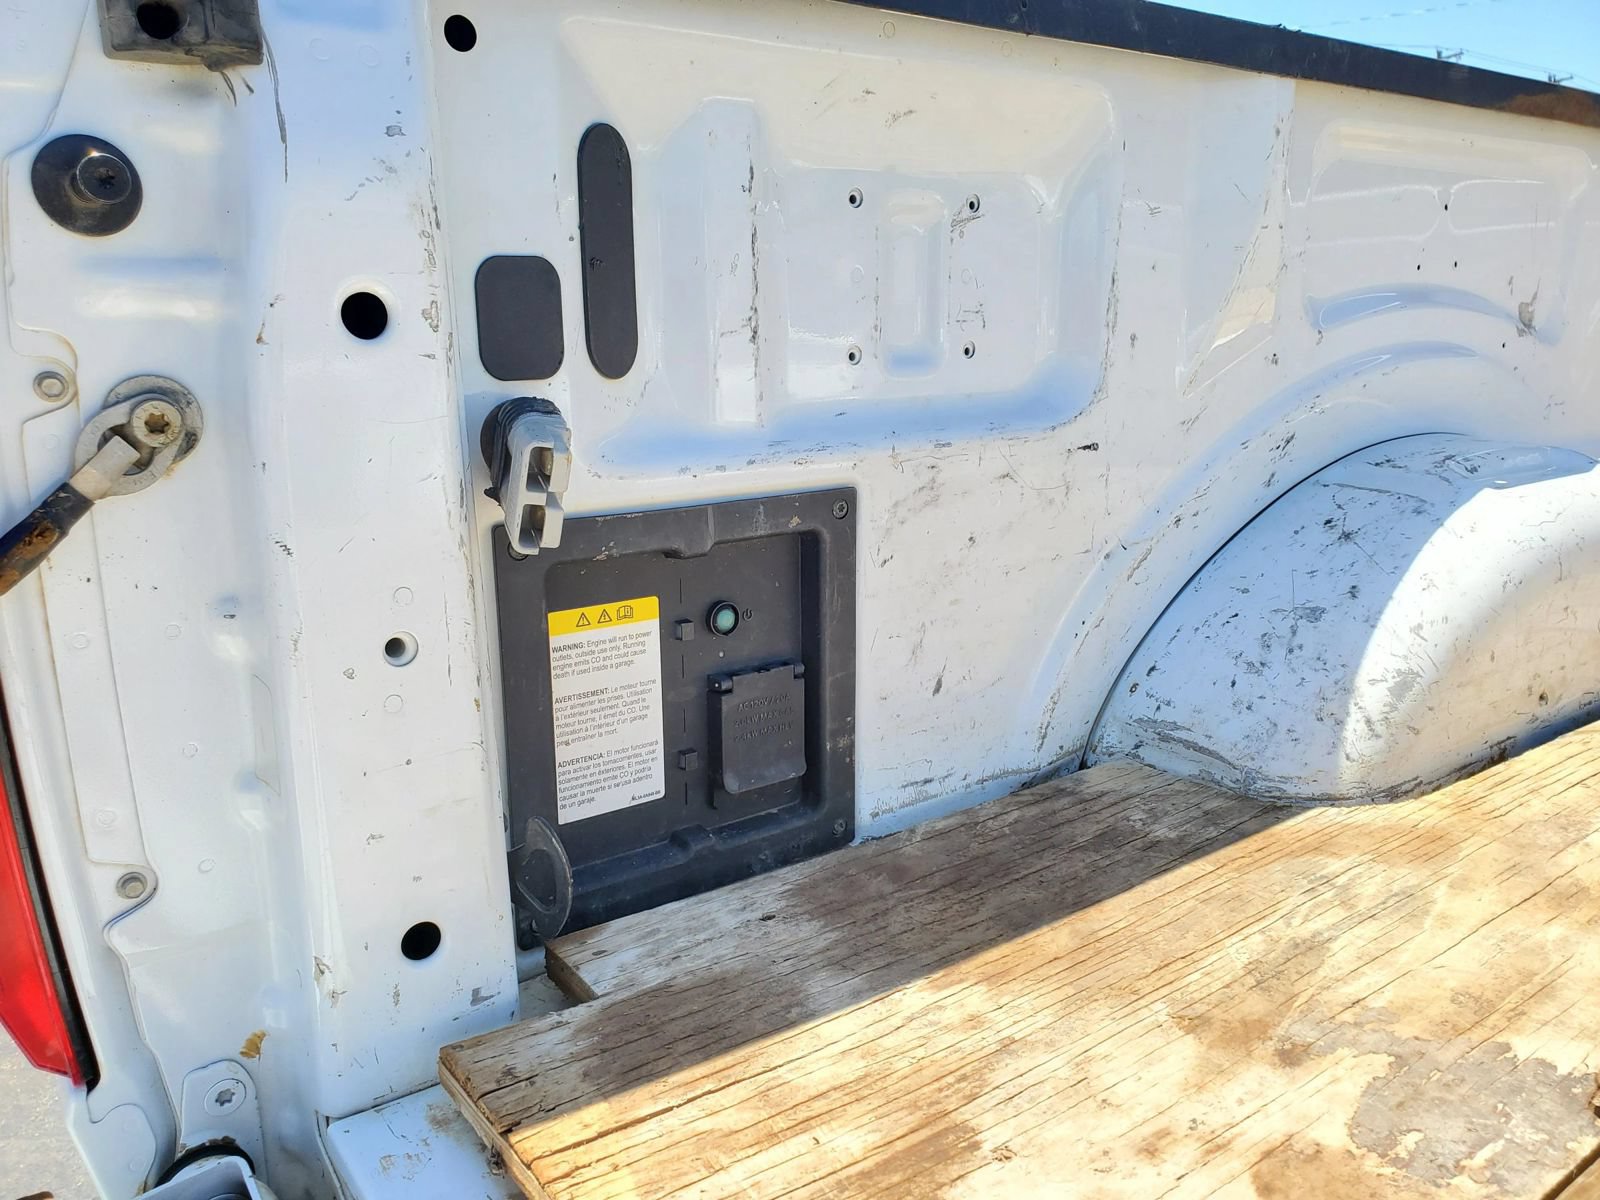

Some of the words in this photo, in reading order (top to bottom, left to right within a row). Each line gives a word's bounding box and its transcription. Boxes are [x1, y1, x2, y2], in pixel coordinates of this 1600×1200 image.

[552, 642, 585, 653] WARNING:
[587, 638, 607, 649] Engine
[635, 630, 652, 640] power
[575, 649, 596, 658] outside
[597, 647, 607, 655] use
[609, 644, 621, 653] only.
[623, 640, 645, 649] Running
[553, 662, 573, 671] engine
[574, 659, 590, 667] emits
[591, 656, 601, 664] CO
[602, 653, 612, 662] and
[614, 650, 629, 660] could
[630, 648, 646, 657] cause
[553, 671, 570, 679] death
[577, 667, 590, 675] used
[592, 663, 608, 672] inside
[615, 659, 635, 669] garage.
[555, 687, 610, 704] AVERTISSEMENT:
[620, 682, 639, 691] moteur
[640, 678, 657, 687] tourne
[570, 700, 596, 709] alimenter
[607, 695, 624, 703] prises.
[627, 687, 652, 698] Utilisation
[556, 721, 576, 730] moteur
[577, 716, 597, 725] tourne,
[603, 711, 618, 719] émet
[619, 708, 625, 716] du
[627, 706, 637, 714] CO.
[561, 708, 589, 720] l'extérieur
[591, 703, 619, 714] seulement.
[622, 698, 640, 707] Quand
[556, 727, 583, 738] utilisation
[590, 721, 615, 731] l'intérieur
[616, 717, 628, 725] d'un
[630, 714, 648, 723] garage
[571, 732, 596, 743] entraîner
[605, 728, 618, 736] mort.
[558, 753, 605, 768] ADVERTENCIA:
[614, 744, 629, 754] motor
[631, 739, 658, 750] funcionará
[558, 769, 574, 777] para
[573, 765, 592, 773] activar
[558, 773, 588, 785] solamente
[635, 758, 650, 767] motor
[559, 779, 602, 794] funcionamiento
[603, 774, 618, 782] emite
[620, 771, 629, 779] CO
[635, 766, 651, 775] podría
[559, 793, 579, 802] causar
[587, 785, 606, 794] muerte
[633, 774, 652, 783] adentro
[577, 796, 596, 807] garaje.
